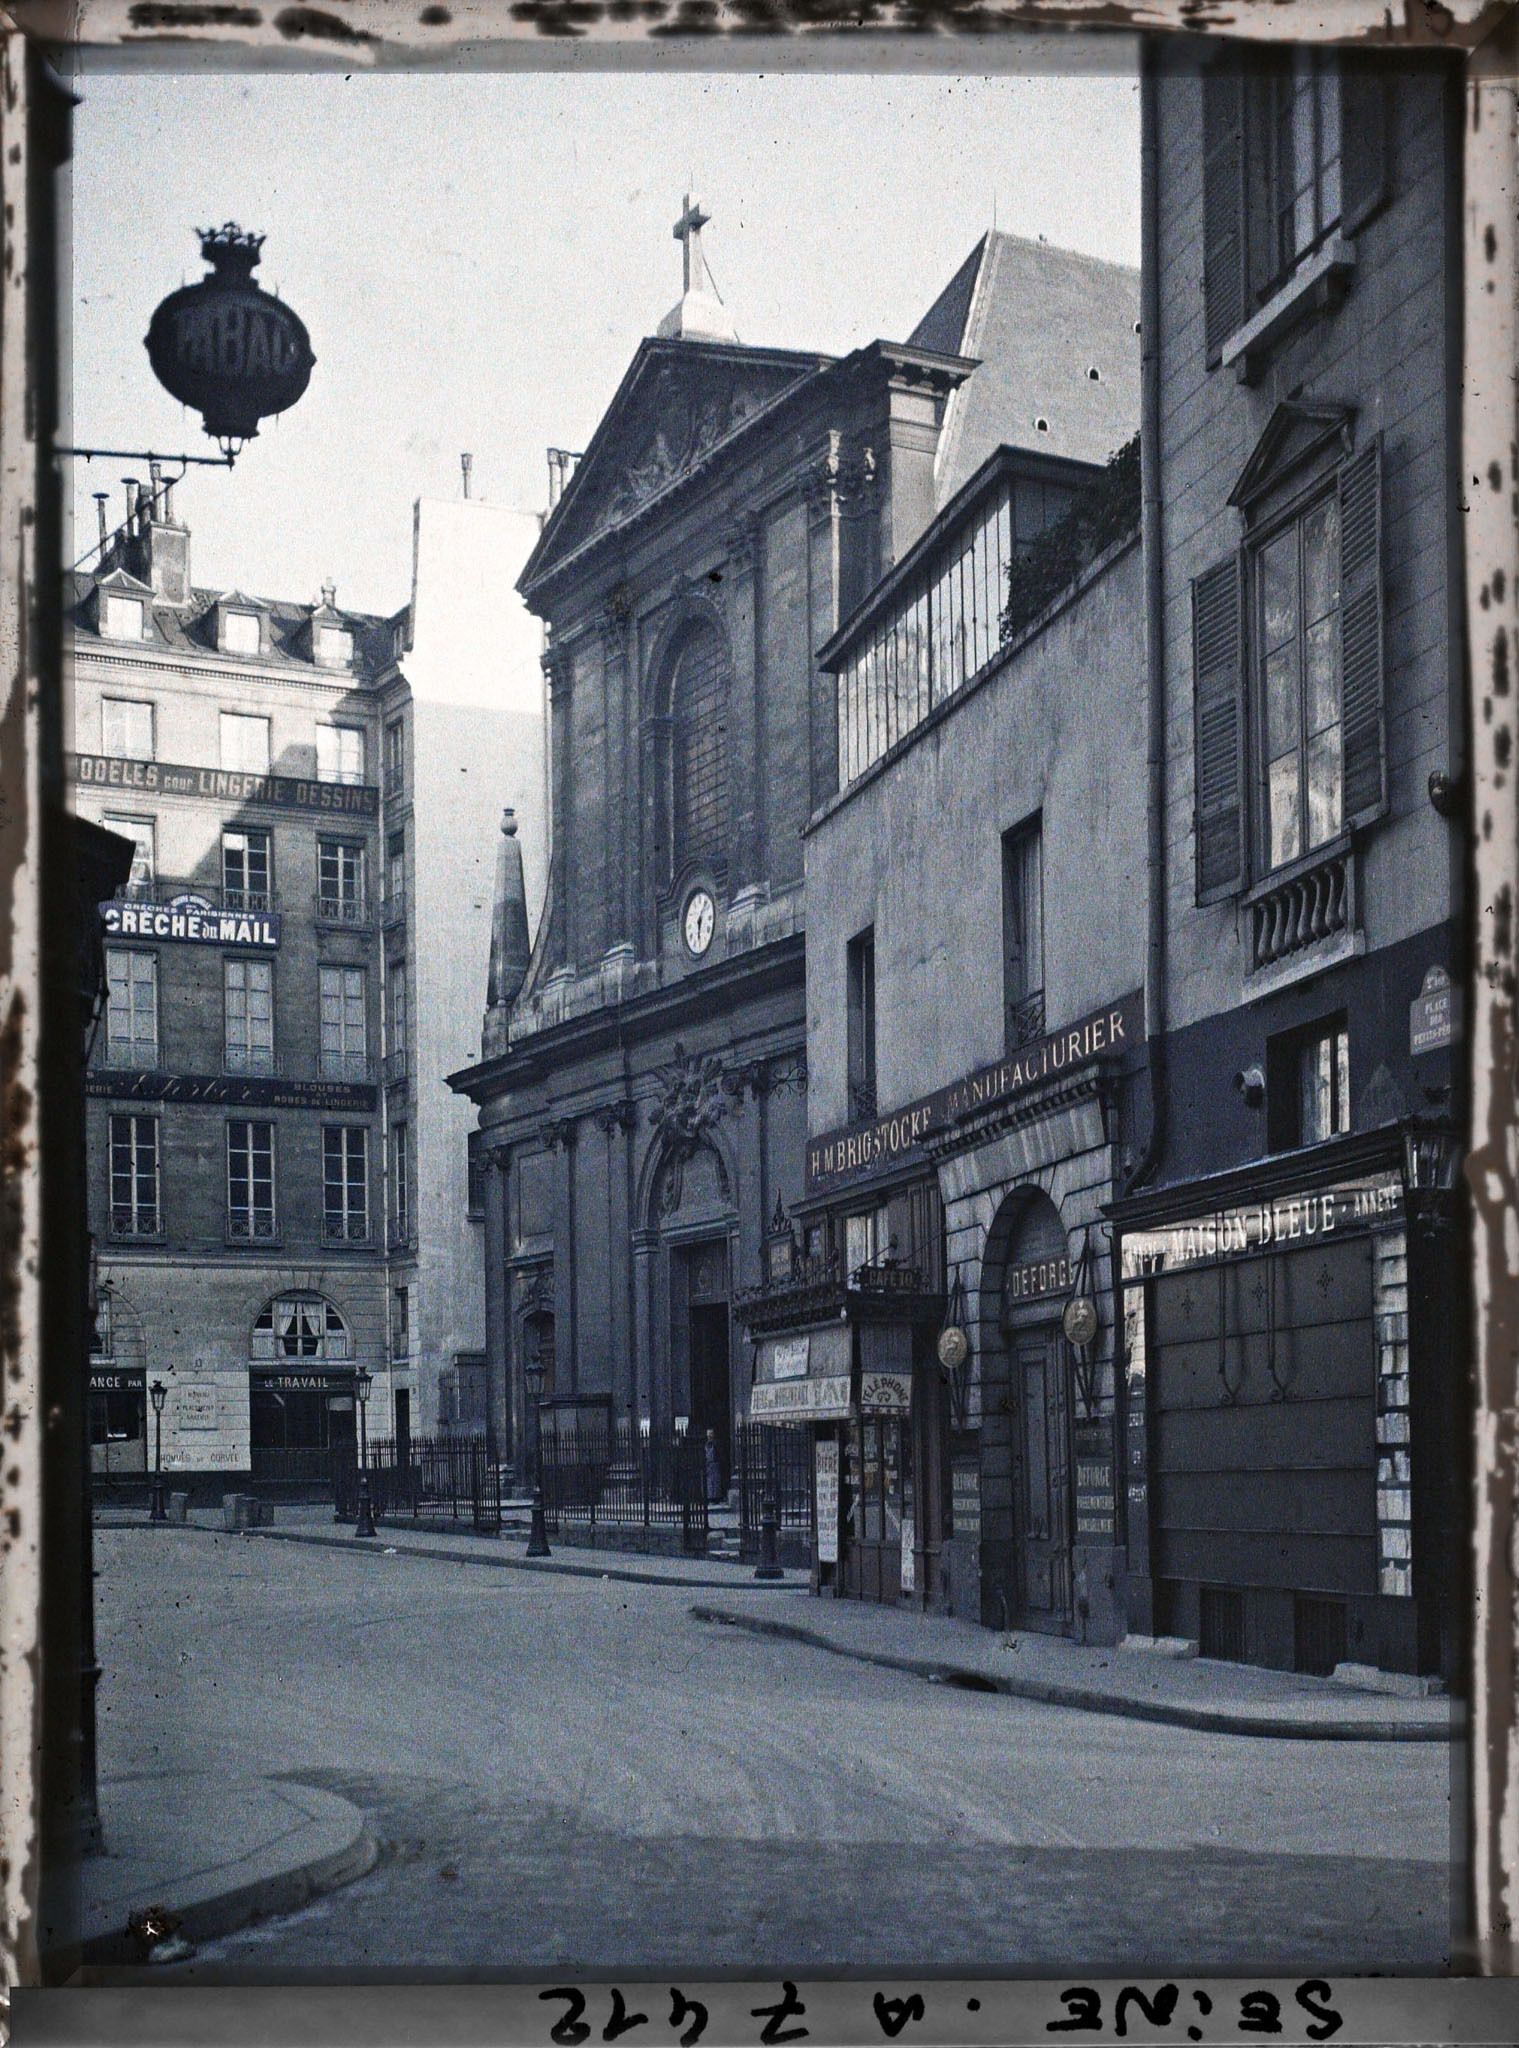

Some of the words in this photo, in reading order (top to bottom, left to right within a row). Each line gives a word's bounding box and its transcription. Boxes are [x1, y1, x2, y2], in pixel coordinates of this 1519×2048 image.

[199, 771, 285, 802] LINGERIE
[219, 918, 277, 945] MAIL
[944, 1010, 1127, 1114] MANUFACTURIER
[1172, 1215, 1248, 1262] MAISON
[1258, 1194, 1336, 1245] BLEUE
[277, 1376, 329, 1388] TRAVAIL
